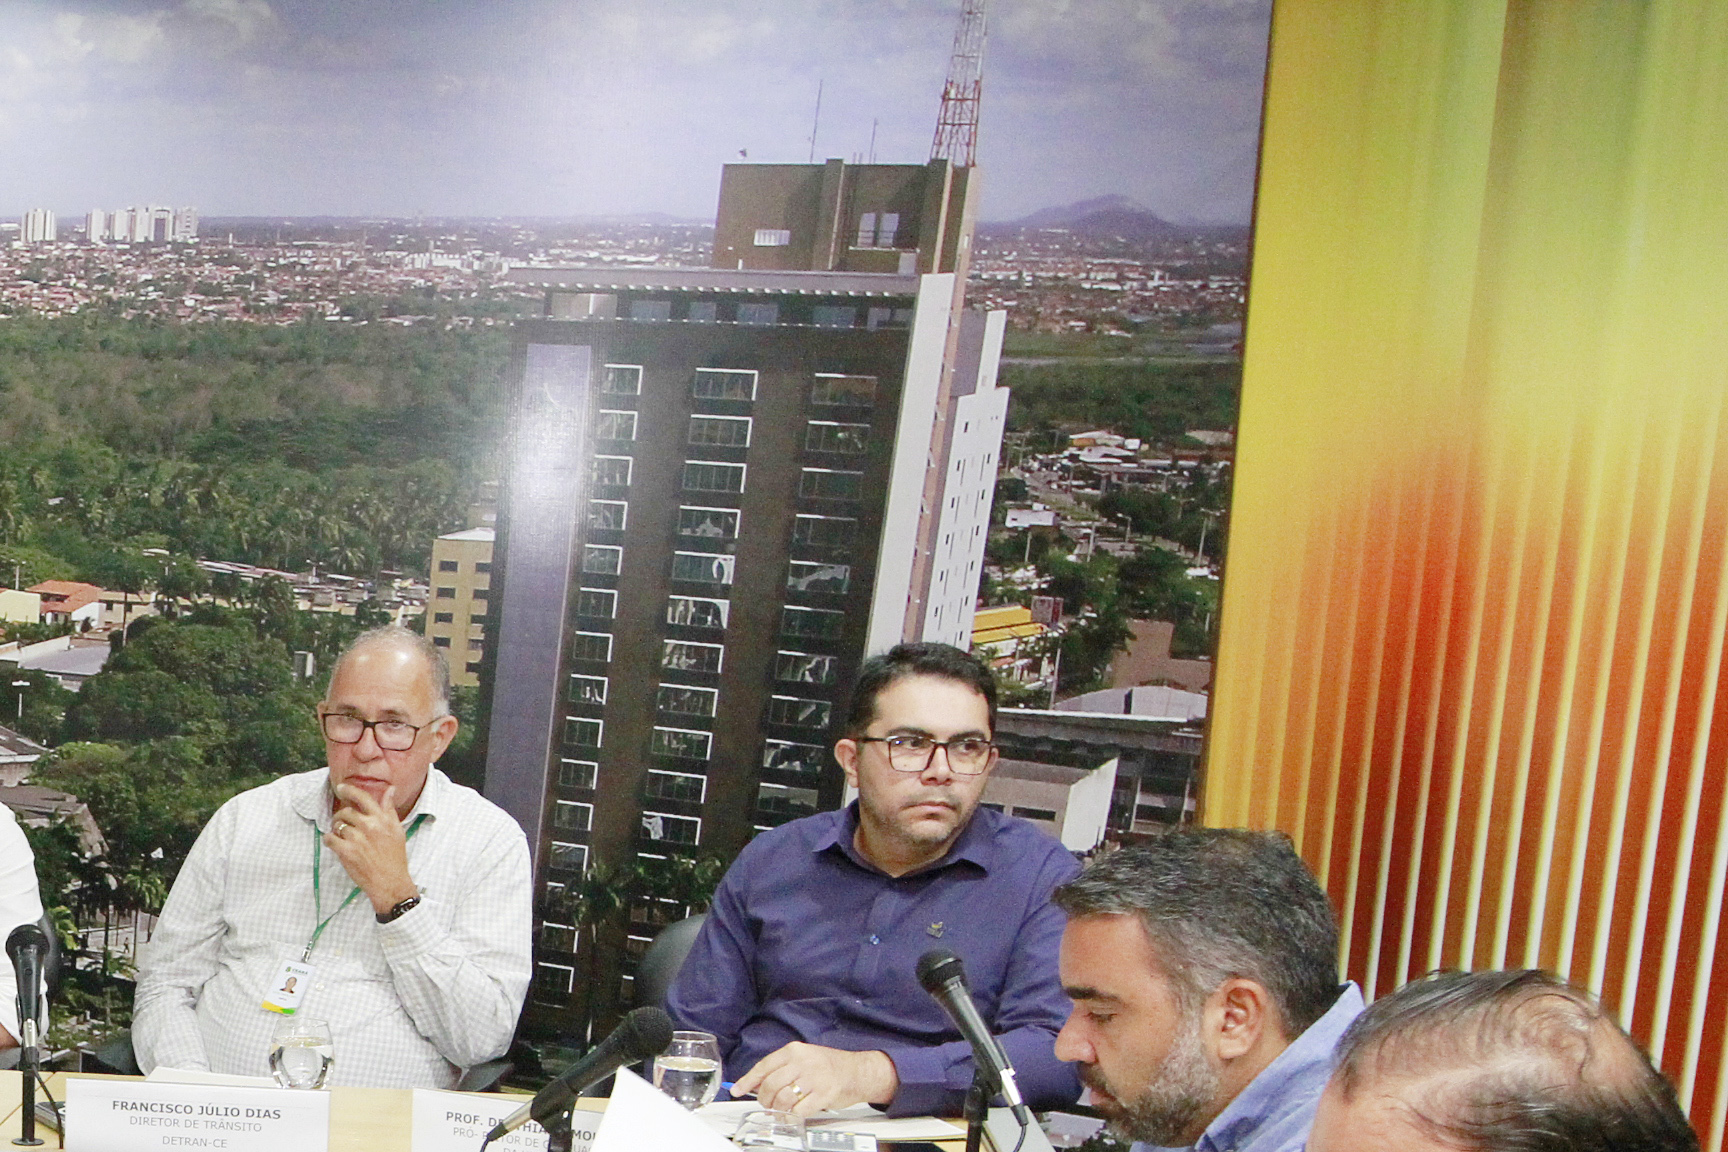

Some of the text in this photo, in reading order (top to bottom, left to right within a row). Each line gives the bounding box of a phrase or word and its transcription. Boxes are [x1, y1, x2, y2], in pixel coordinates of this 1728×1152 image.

[112, 1100, 281, 1120] FRANCISCO JÚLIO DIAS
[129, 1115, 262, 1132] DIRETOR DE TRÂNSITO
[446, 1111, 483, 1126] PROF.
[162, 1136, 227, 1148] DETRAN-CE
[525, 1137, 539, 1148] DE
